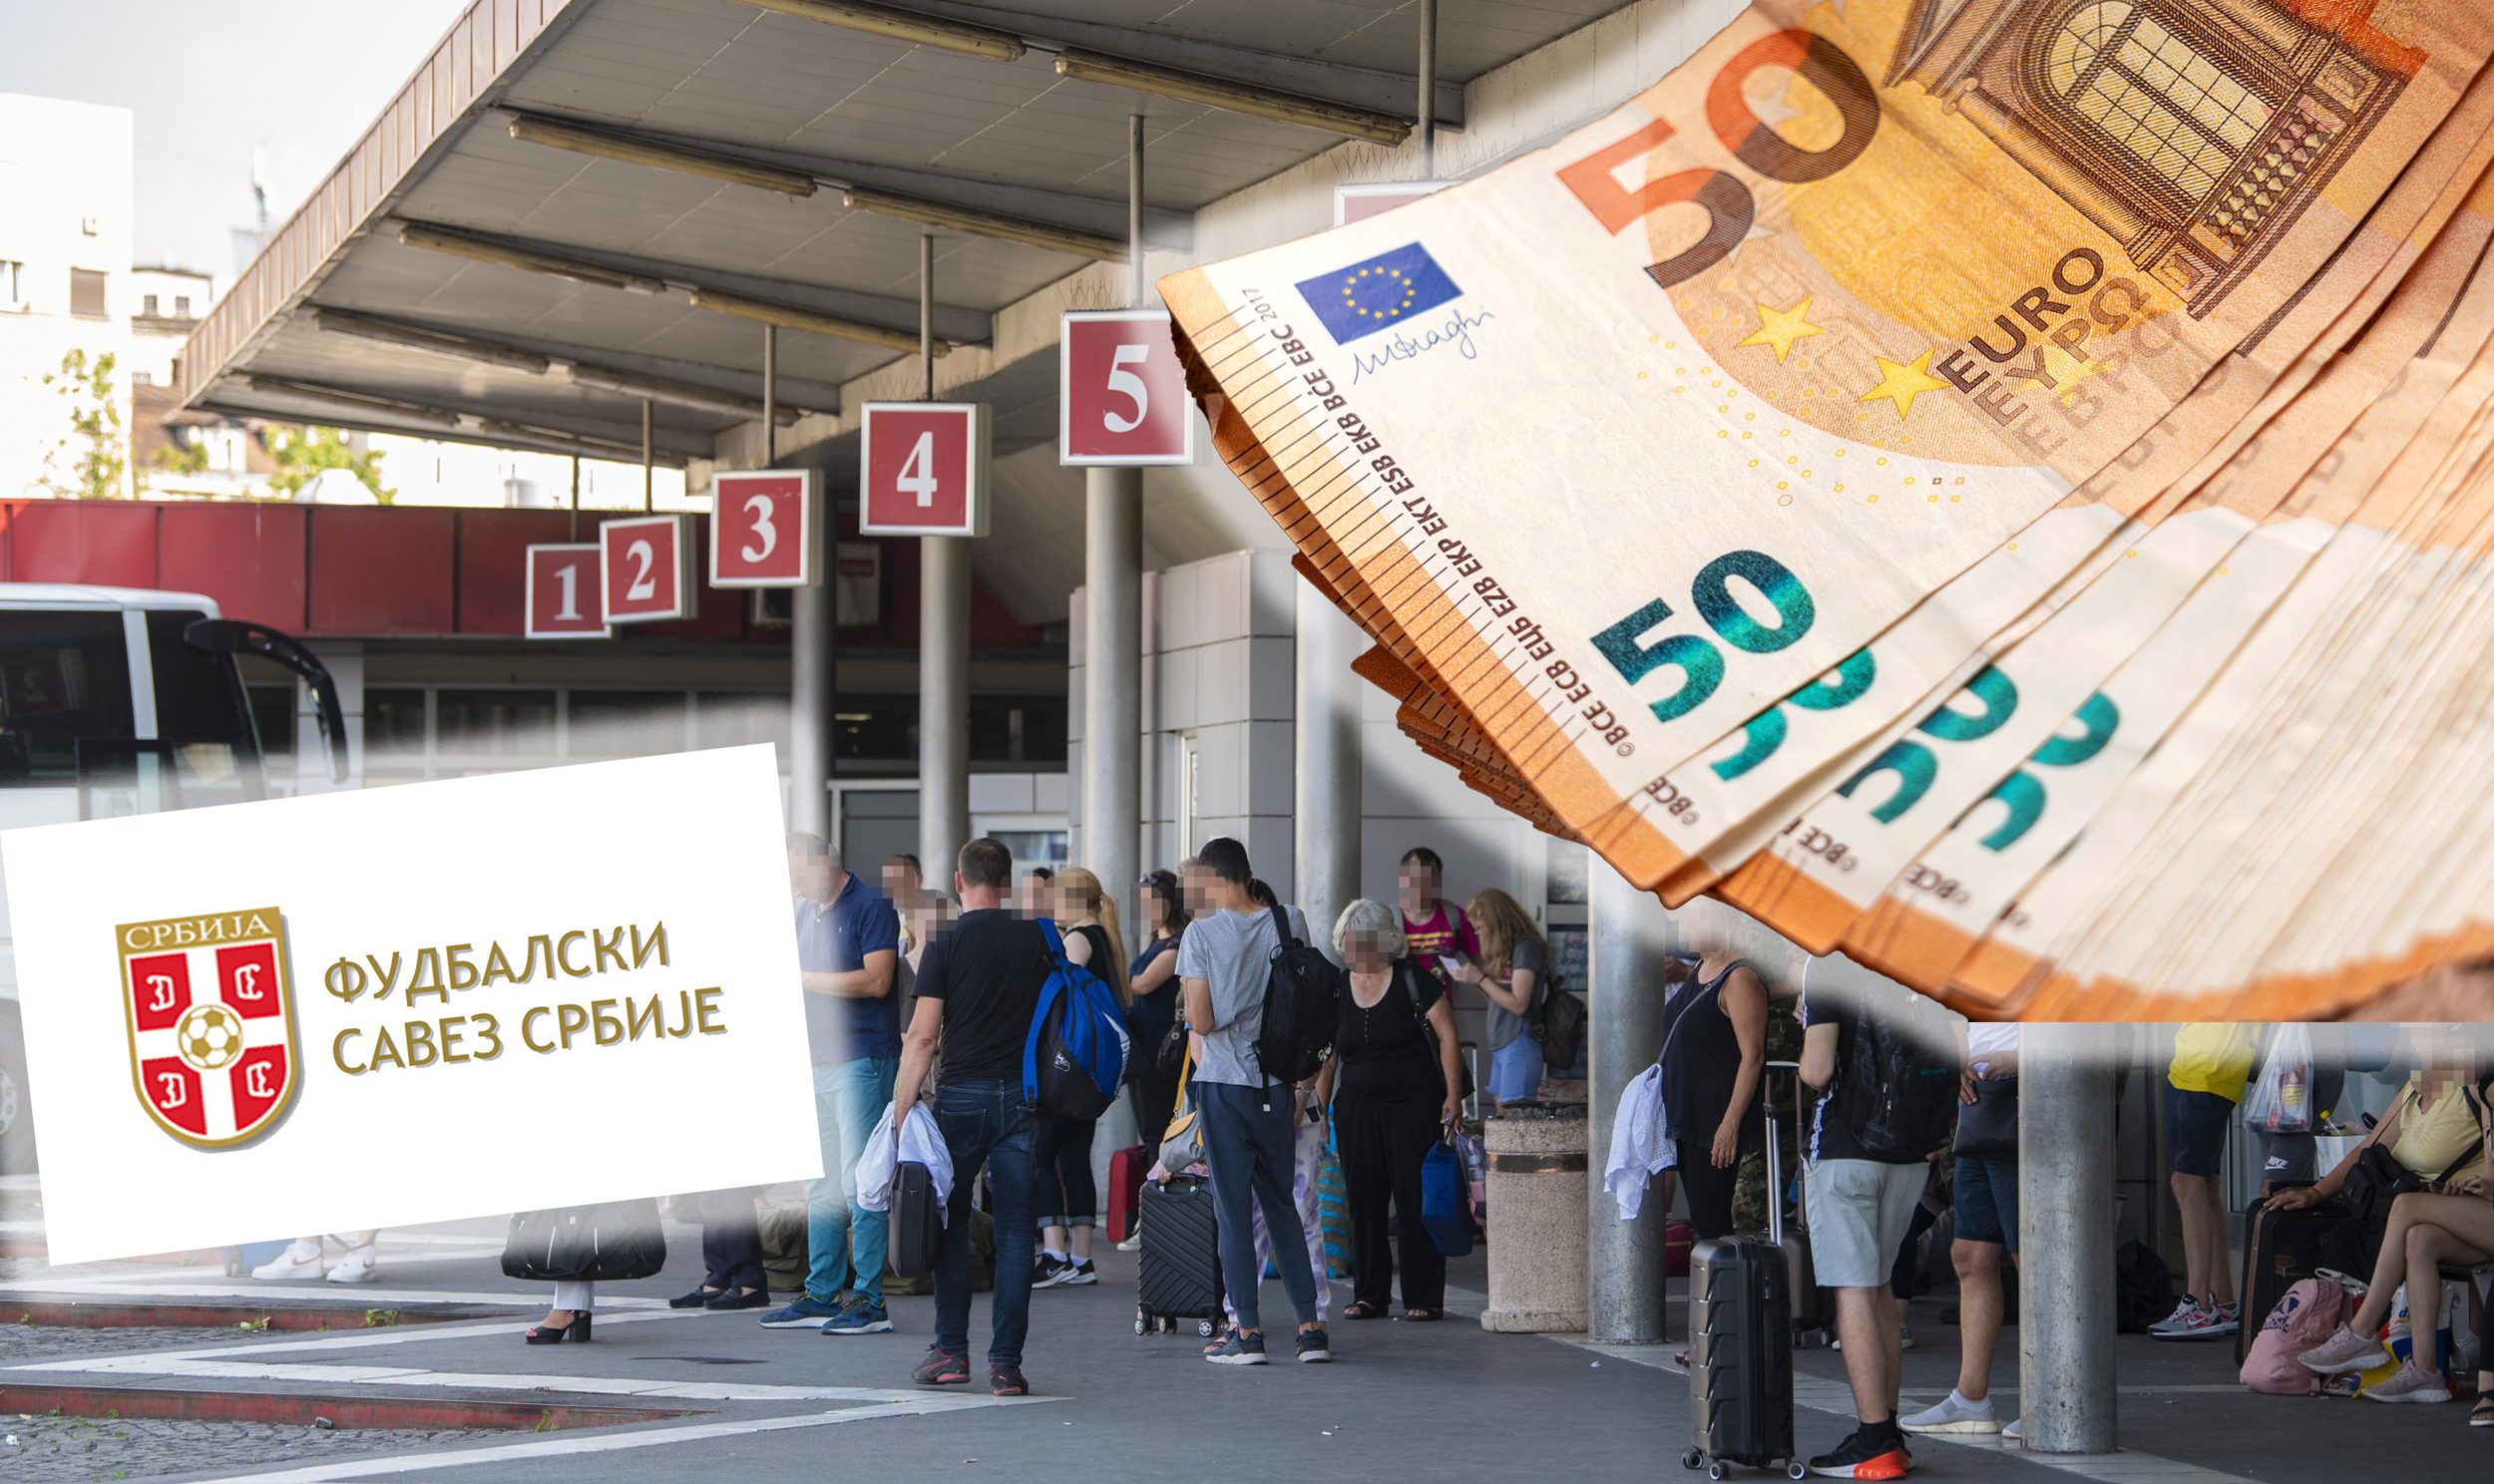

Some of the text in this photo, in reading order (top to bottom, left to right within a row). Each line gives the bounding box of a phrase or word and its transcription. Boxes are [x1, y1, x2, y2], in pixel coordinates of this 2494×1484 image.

[1554, 29, 1880, 289] 50
[1242, 288, 1278, 322] 2017
[1936, 247, 2105, 394] EURO
[1271, 324, 1315, 367] EBC
[1103, 344, 1149, 433] 5
[1337, 413, 1382, 455] EKB
[896, 431, 938, 507] 4
[1371, 455, 1415, 496] ESB
[741, 494, 776, 563] 3
[1402, 497, 1449, 537] EKT
[625, 540, 655, 600] 2
[1438, 539, 1482, 577] EKP
[554, 563, 584, 620] 1
[1473, 576, 1517, 618] EZB
[1589, 550, 1816, 723] 50
[1545, 659, 1592, 704] ECB
